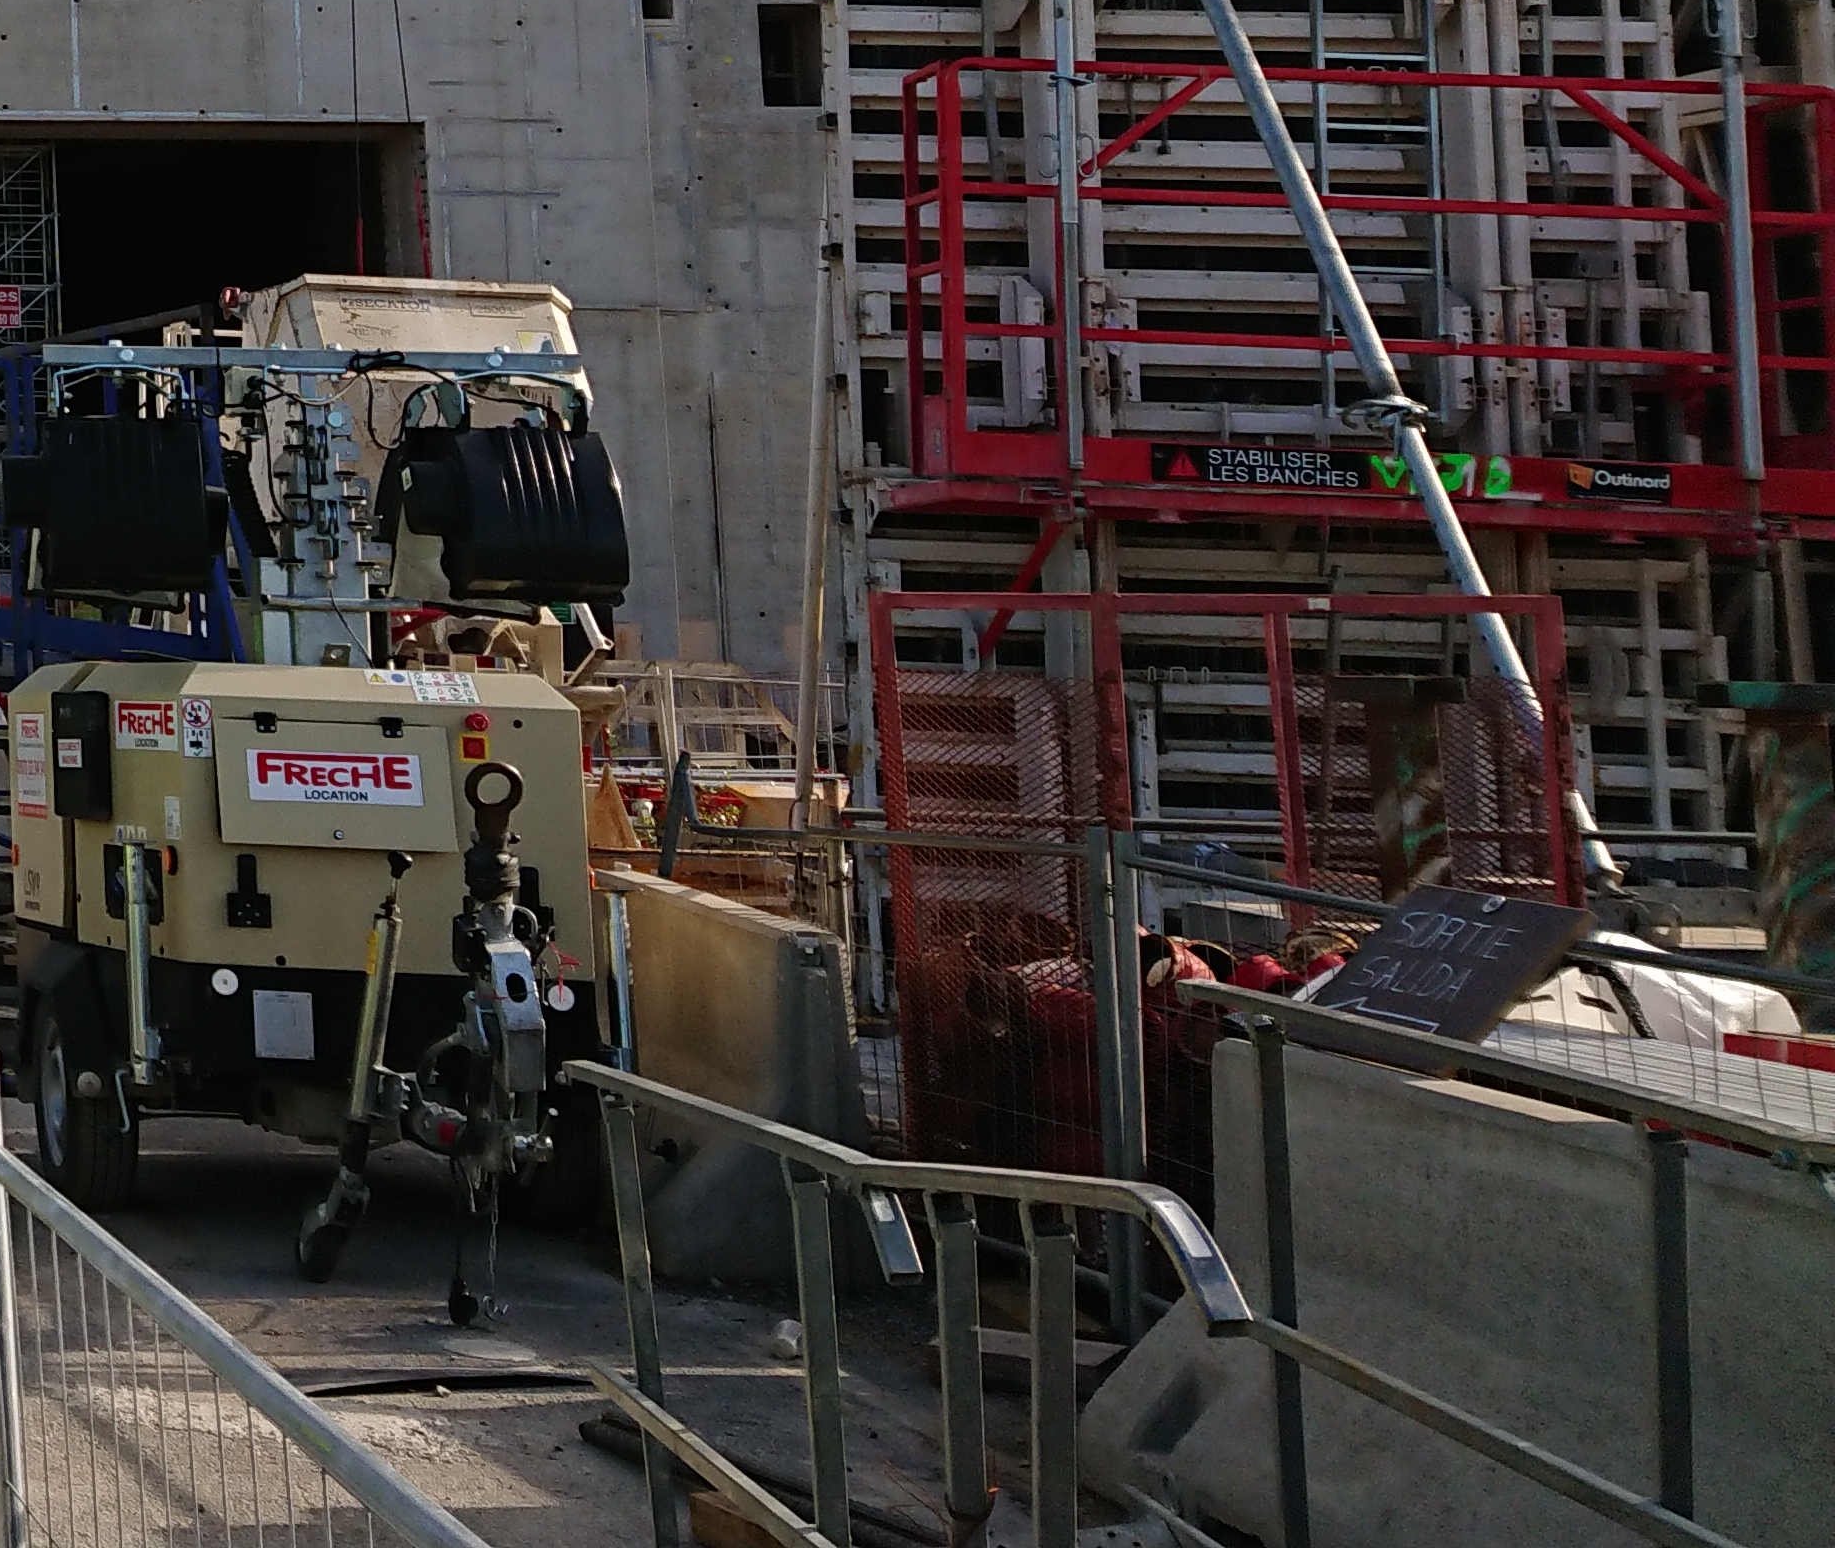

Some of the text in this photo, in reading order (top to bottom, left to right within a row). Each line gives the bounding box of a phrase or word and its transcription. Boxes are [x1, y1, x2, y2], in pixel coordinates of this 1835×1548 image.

[1208, 448, 1331, 469] STABILISER
[1209, 466, 1249, 482] LES
[1256, 468, 1359, 488] BANCHES
[1594, 469, 1670, 489] Outinord
[119, 703, 175, 735] FRECHE
[257, 753, 413, 789] FRECHE
[304, 790, 368, 802] LOCATION
[1394, 911, 1523, 960] SORTIE
[1349, 956, 1473, 1002] SALIDA
